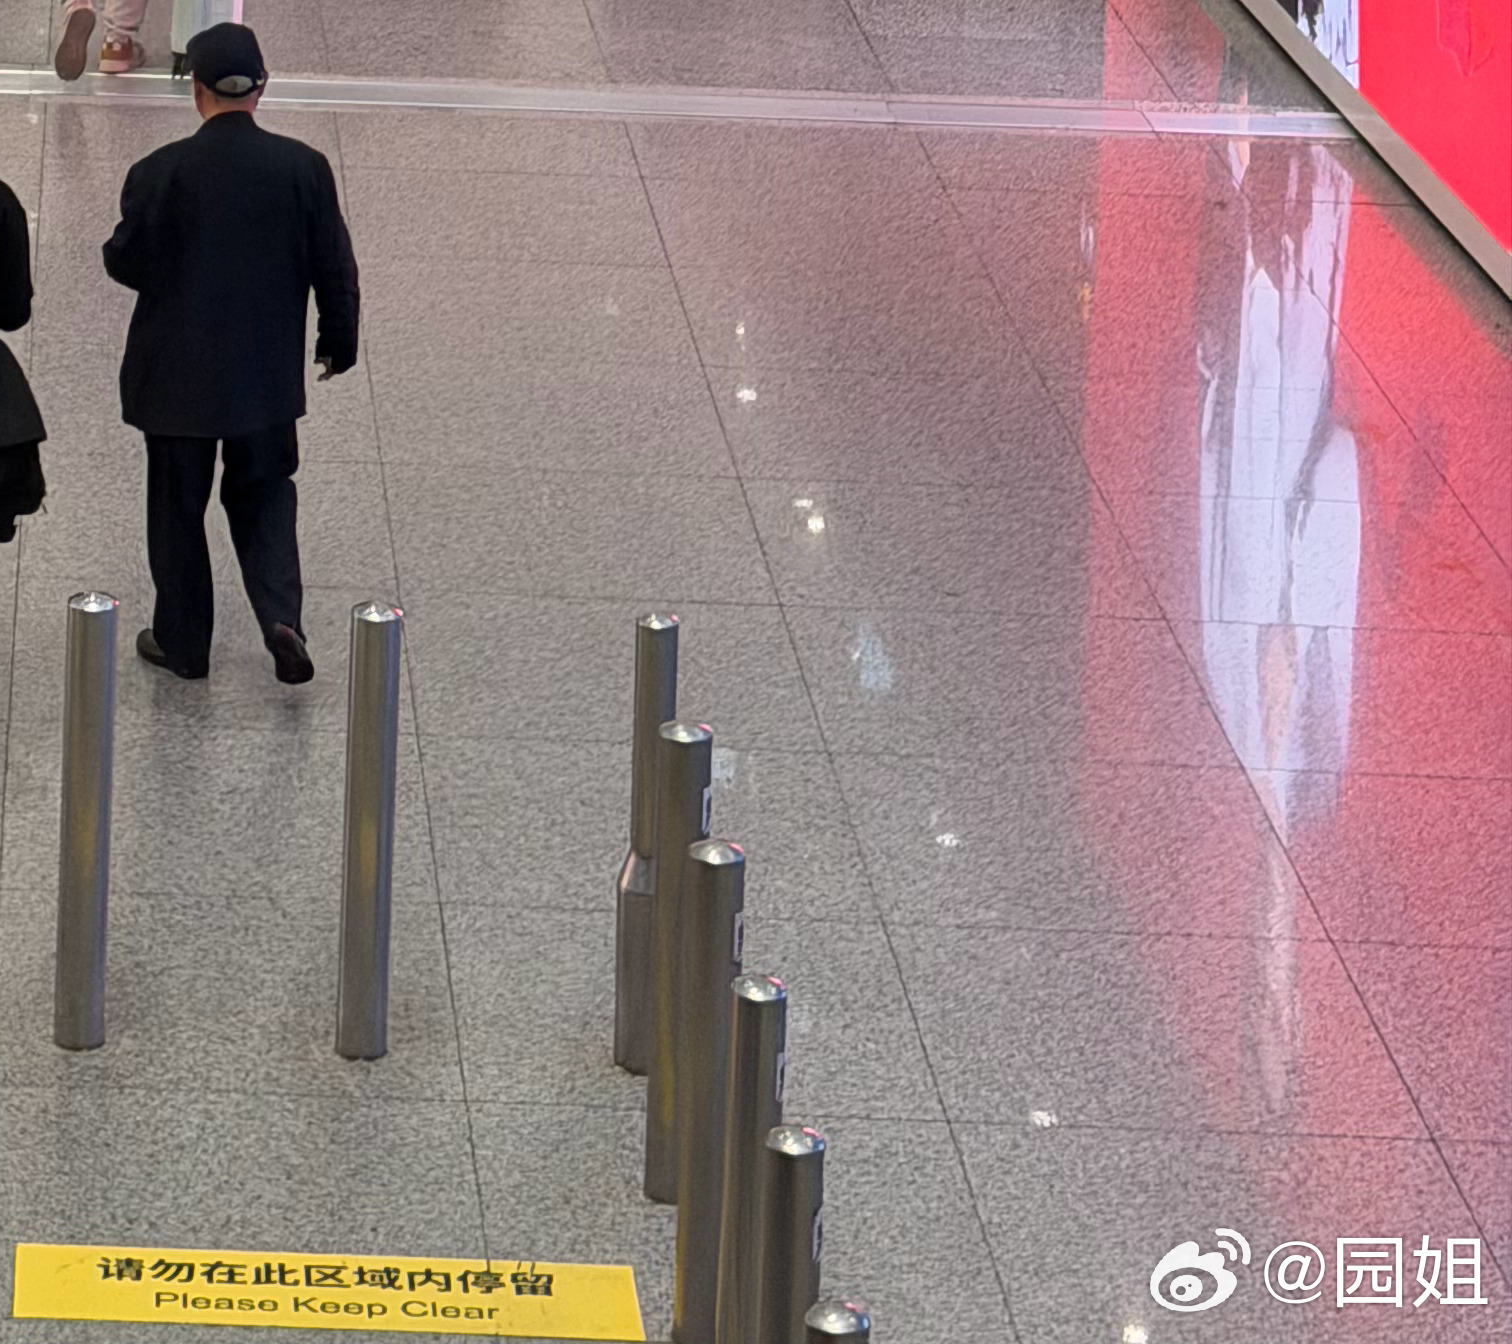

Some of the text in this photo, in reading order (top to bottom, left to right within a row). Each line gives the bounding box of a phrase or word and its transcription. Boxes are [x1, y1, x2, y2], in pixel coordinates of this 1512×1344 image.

[96, 1255, 555, 1297] 请勿在此区域内停留
[153, 1289, 500, 1321] Please Keep Clear
